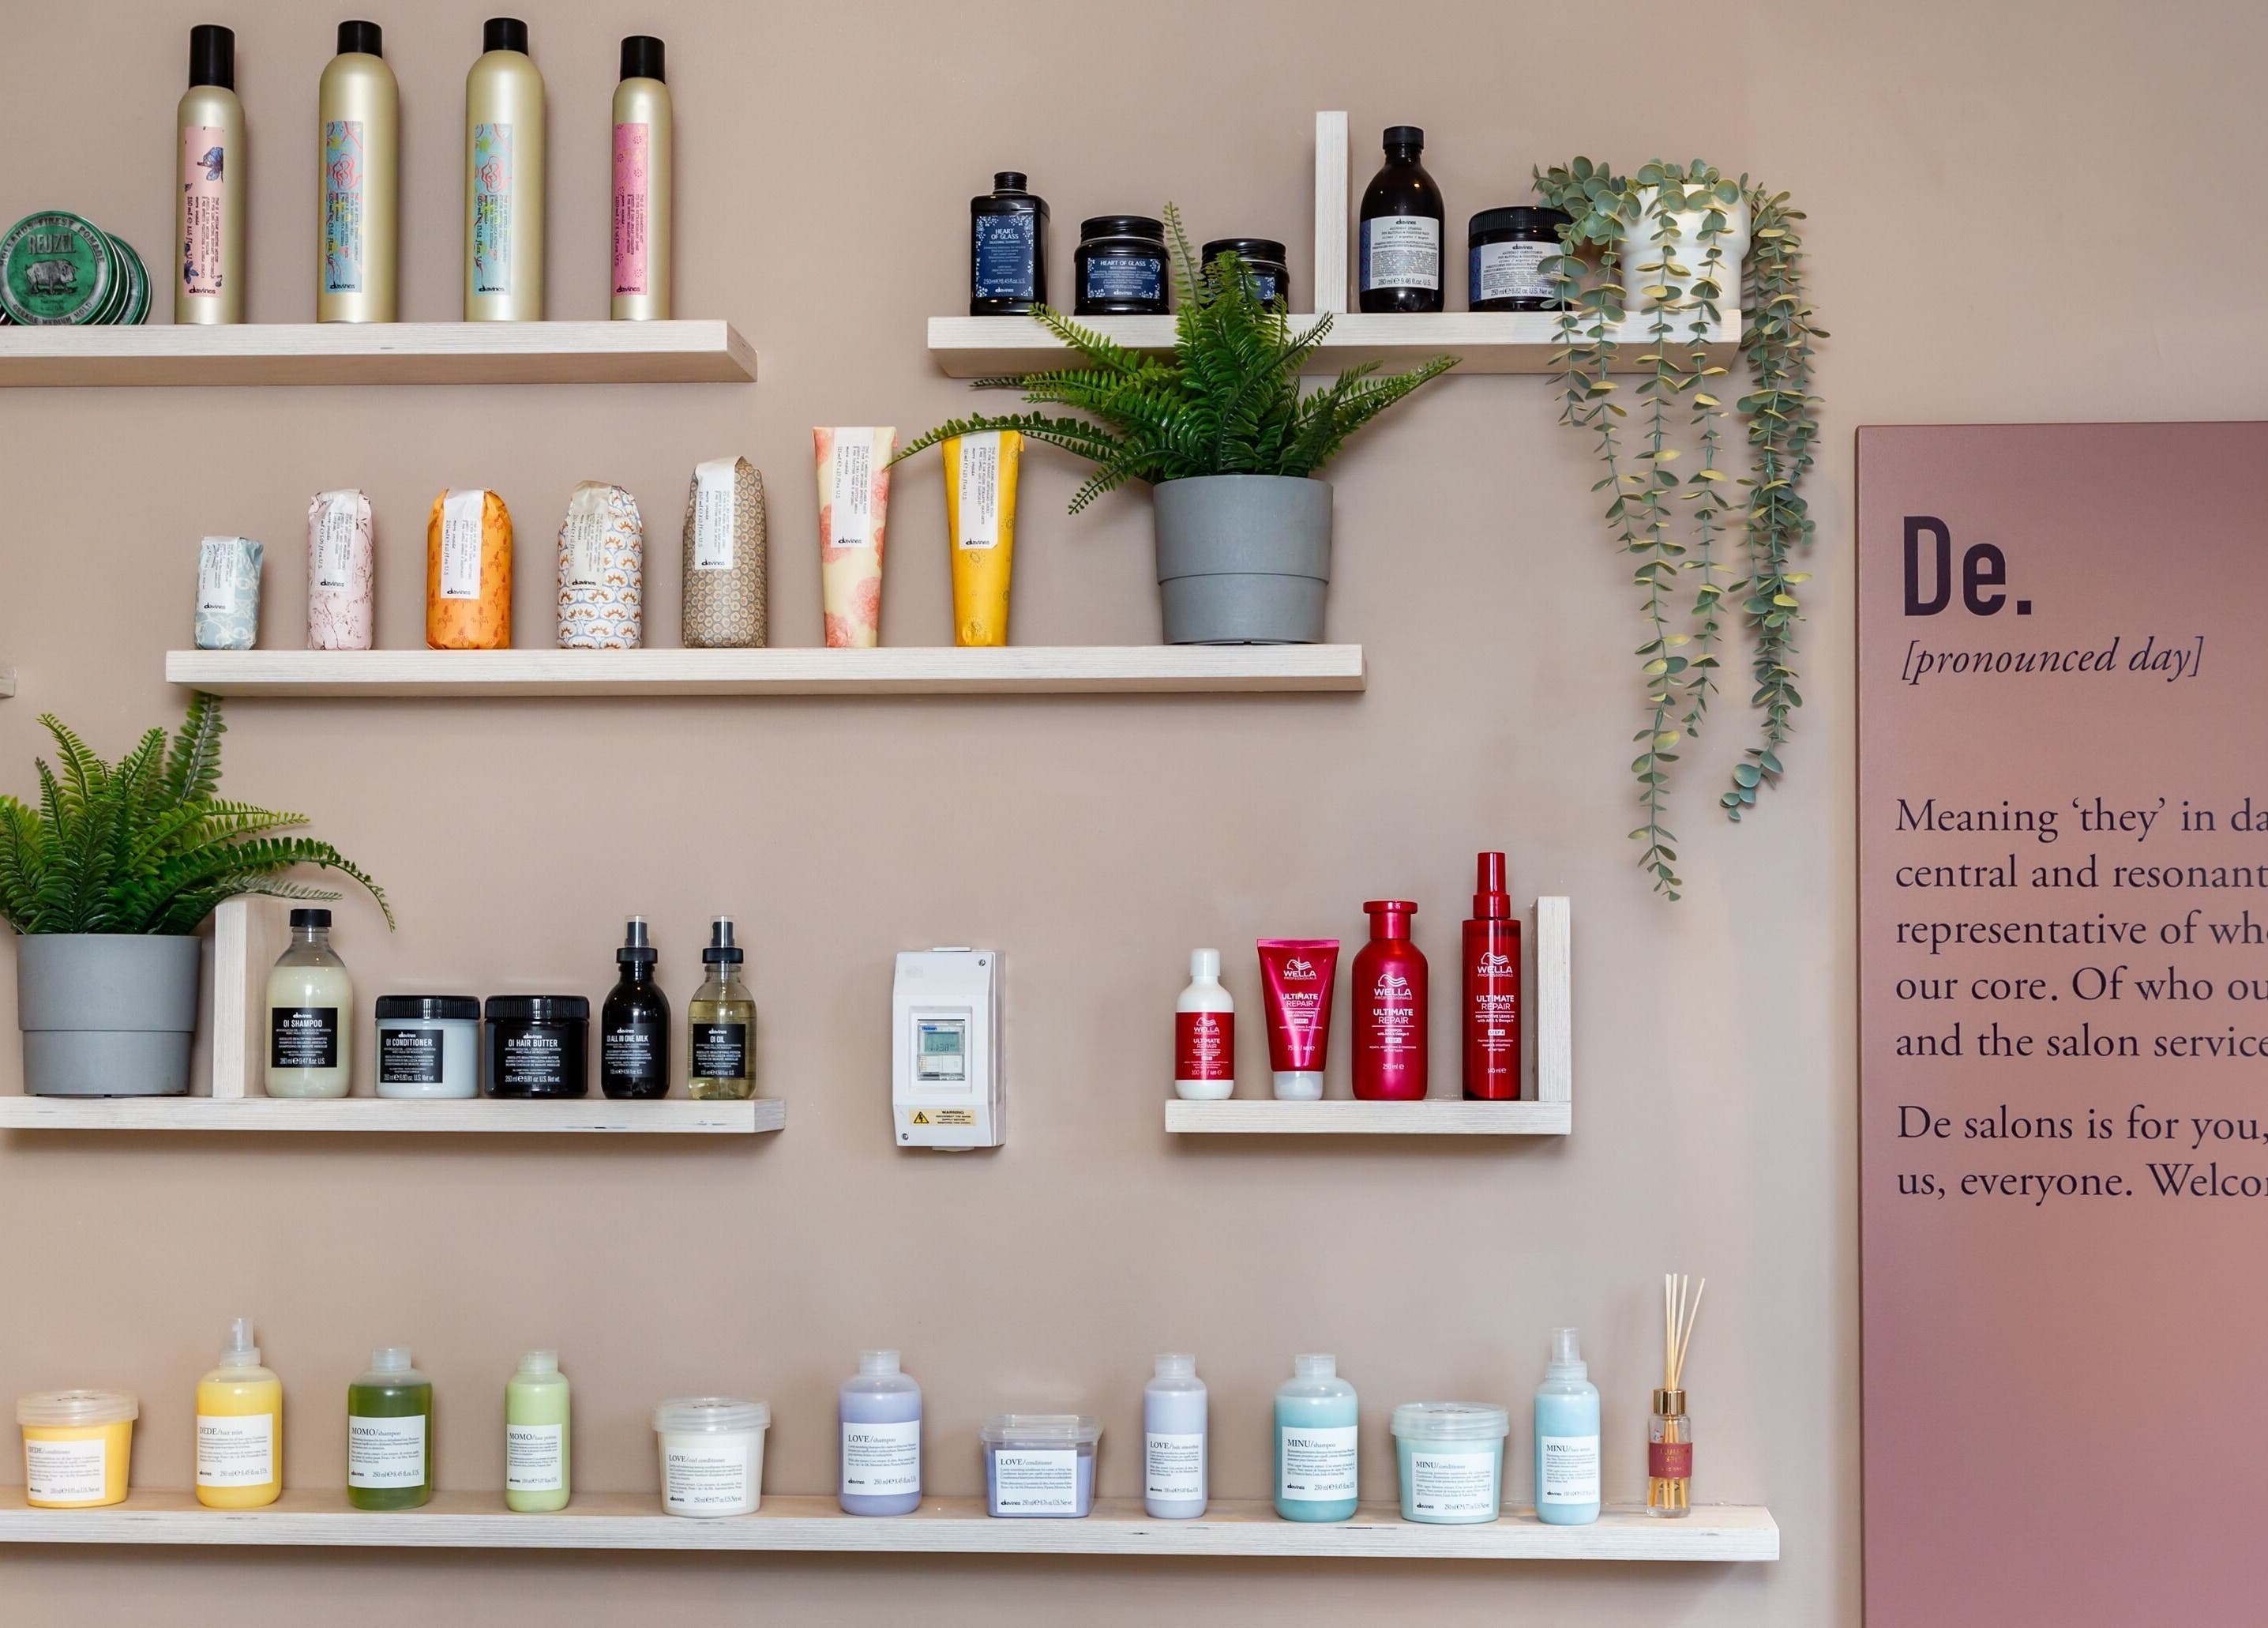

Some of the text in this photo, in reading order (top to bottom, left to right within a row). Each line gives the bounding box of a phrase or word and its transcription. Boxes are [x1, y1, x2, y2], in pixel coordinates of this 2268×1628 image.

[28, 233, 77, 254] REUZEL
[190, 284, 216, 294] davines
[329, 280, 355, 290] davines
[616, 284, 640, 293] davines
[320, 577, 344, 587] davines
[1904, 516, 2032, 616] De.
[1902, 636, 2204, 686] [pronounced day]
[1895, 799, 2059, 843] Meaning
[2181, 801, 2216, 831] in
[1895, 853, 2268, 888] central and resonant
[1896, 909, 2268, 955] representative of wh
[1896, 979, 1958, 1001] our
[1971, 979, 2058, 1001] core.
[2072, 965, 2128, 1001] Of
[2134, 965, 2214, 1001] who
[1896, 1021, 1964, 1057] and
[1977, 1022, 2033, 1057] the
[2047, 1022, 2141, 1057] salon
[1898, 1104, 2268, 1150] De salons is for you,
[1898, 1162, 2268, 1207] us, everyone. Welco
